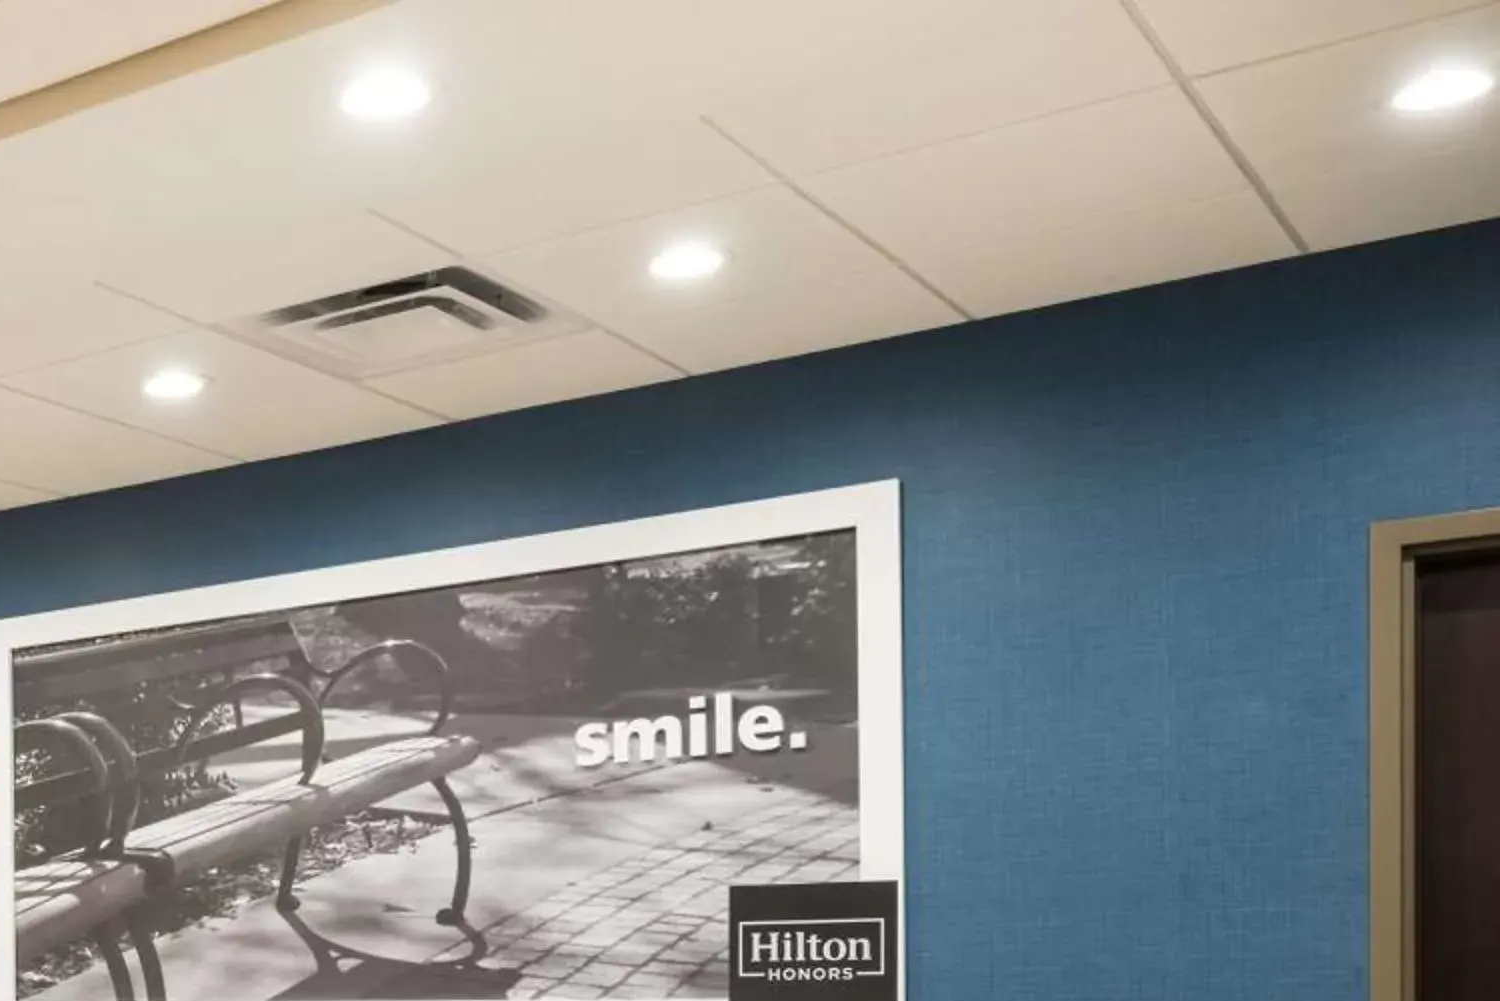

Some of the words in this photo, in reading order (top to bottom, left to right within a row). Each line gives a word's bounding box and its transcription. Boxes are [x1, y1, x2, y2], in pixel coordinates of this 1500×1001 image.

[574, 692, 807, 767] smile.
[750, 931, 873, 962] Hilton
[767, 967, 854, 981] HONORS
